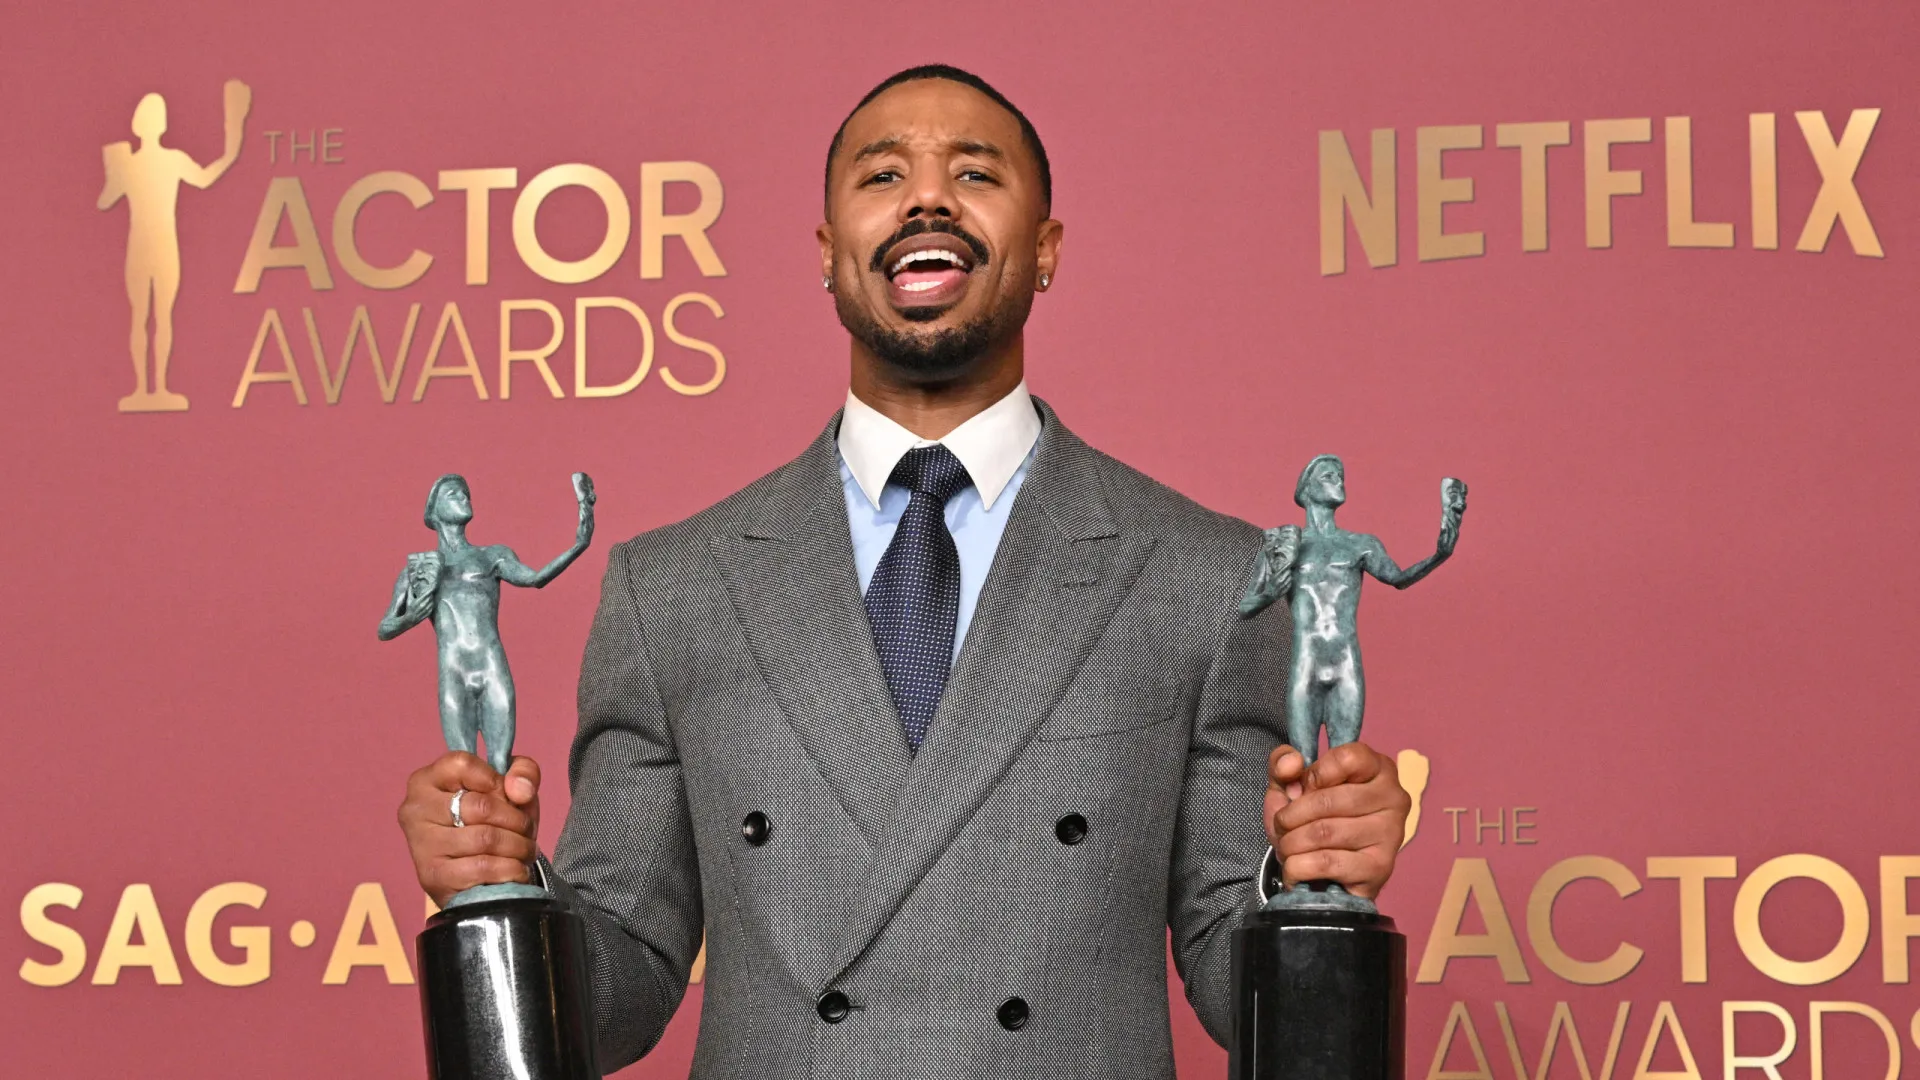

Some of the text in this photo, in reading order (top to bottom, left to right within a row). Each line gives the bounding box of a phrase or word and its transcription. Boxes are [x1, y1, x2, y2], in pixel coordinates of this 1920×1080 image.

[263, 128, 345, 163] THE
[1318, 107, 1885, 277] NETFLIX
[233, 160, 727, 293] ACTOR
[231, 292, 727, 409] AWARDS
[1443, 807, 1538, 844] THE
[1428, 1000, 1920, 1080] AWARD
